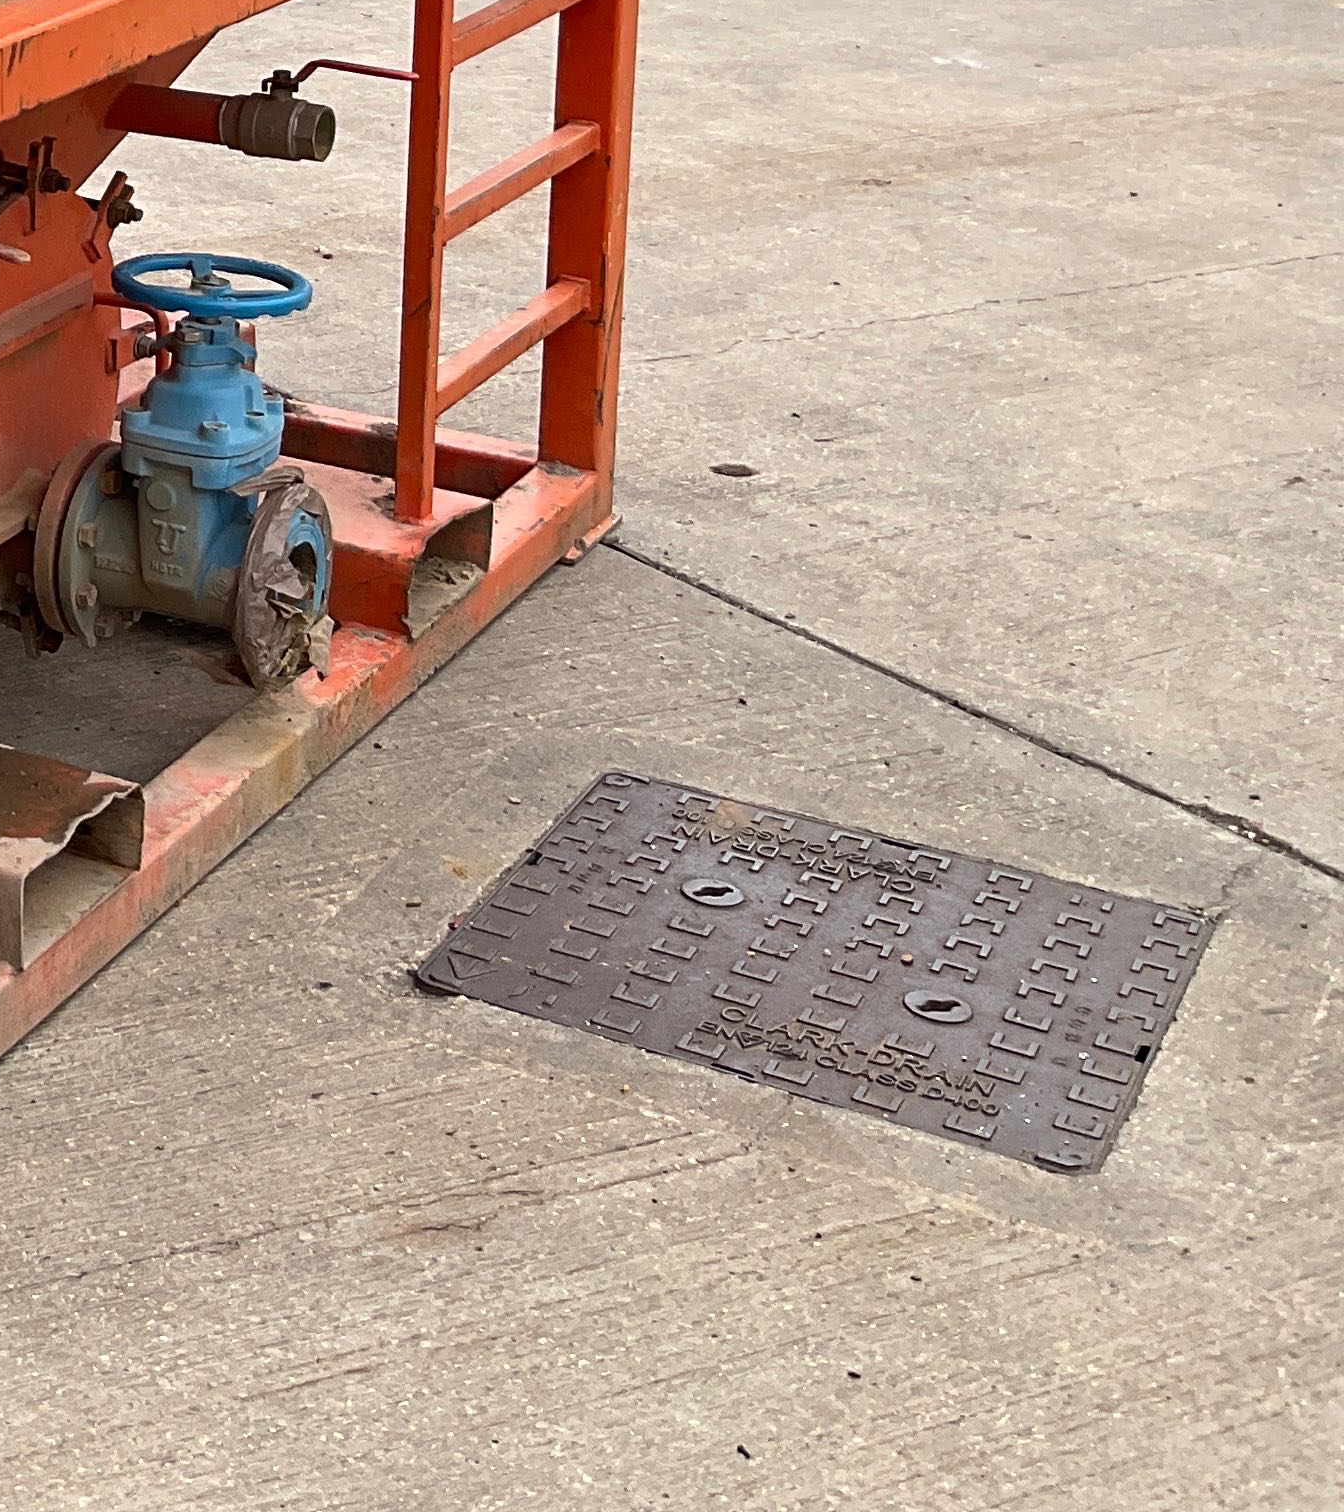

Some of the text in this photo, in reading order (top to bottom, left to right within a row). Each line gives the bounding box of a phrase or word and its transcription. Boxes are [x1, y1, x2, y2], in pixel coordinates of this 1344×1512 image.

[671, 822, 915, 892] CLARK-DRAIN
[719, 1006, 996, 1098] CLARK-DRAIN
[814, 1055, 918, 1093] CLASS
